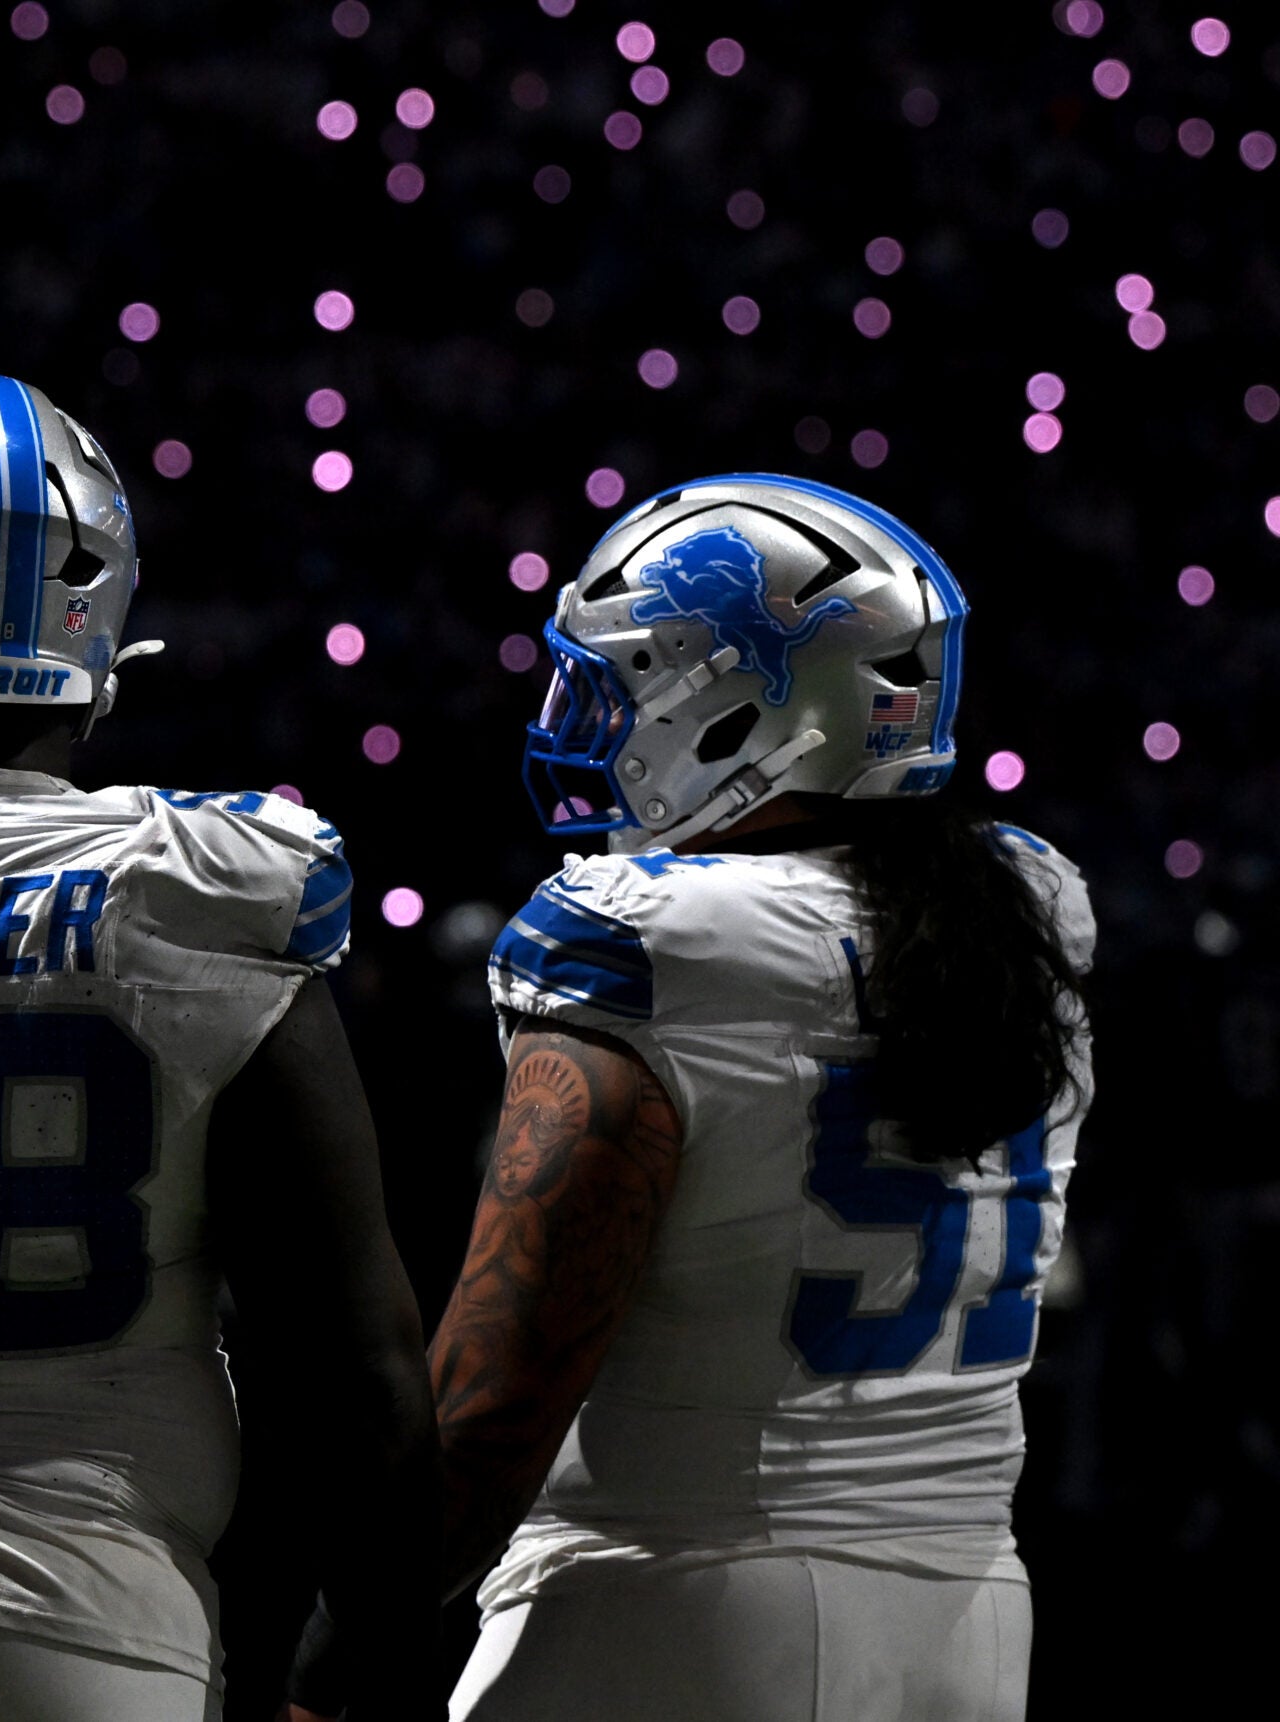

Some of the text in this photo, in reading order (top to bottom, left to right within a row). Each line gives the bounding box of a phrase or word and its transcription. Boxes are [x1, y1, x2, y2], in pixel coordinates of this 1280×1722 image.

[66, 612, 85, 630] NFL
[865, 732, 913, 751] WCF
[779, 1055, 1052, 1376] 51
